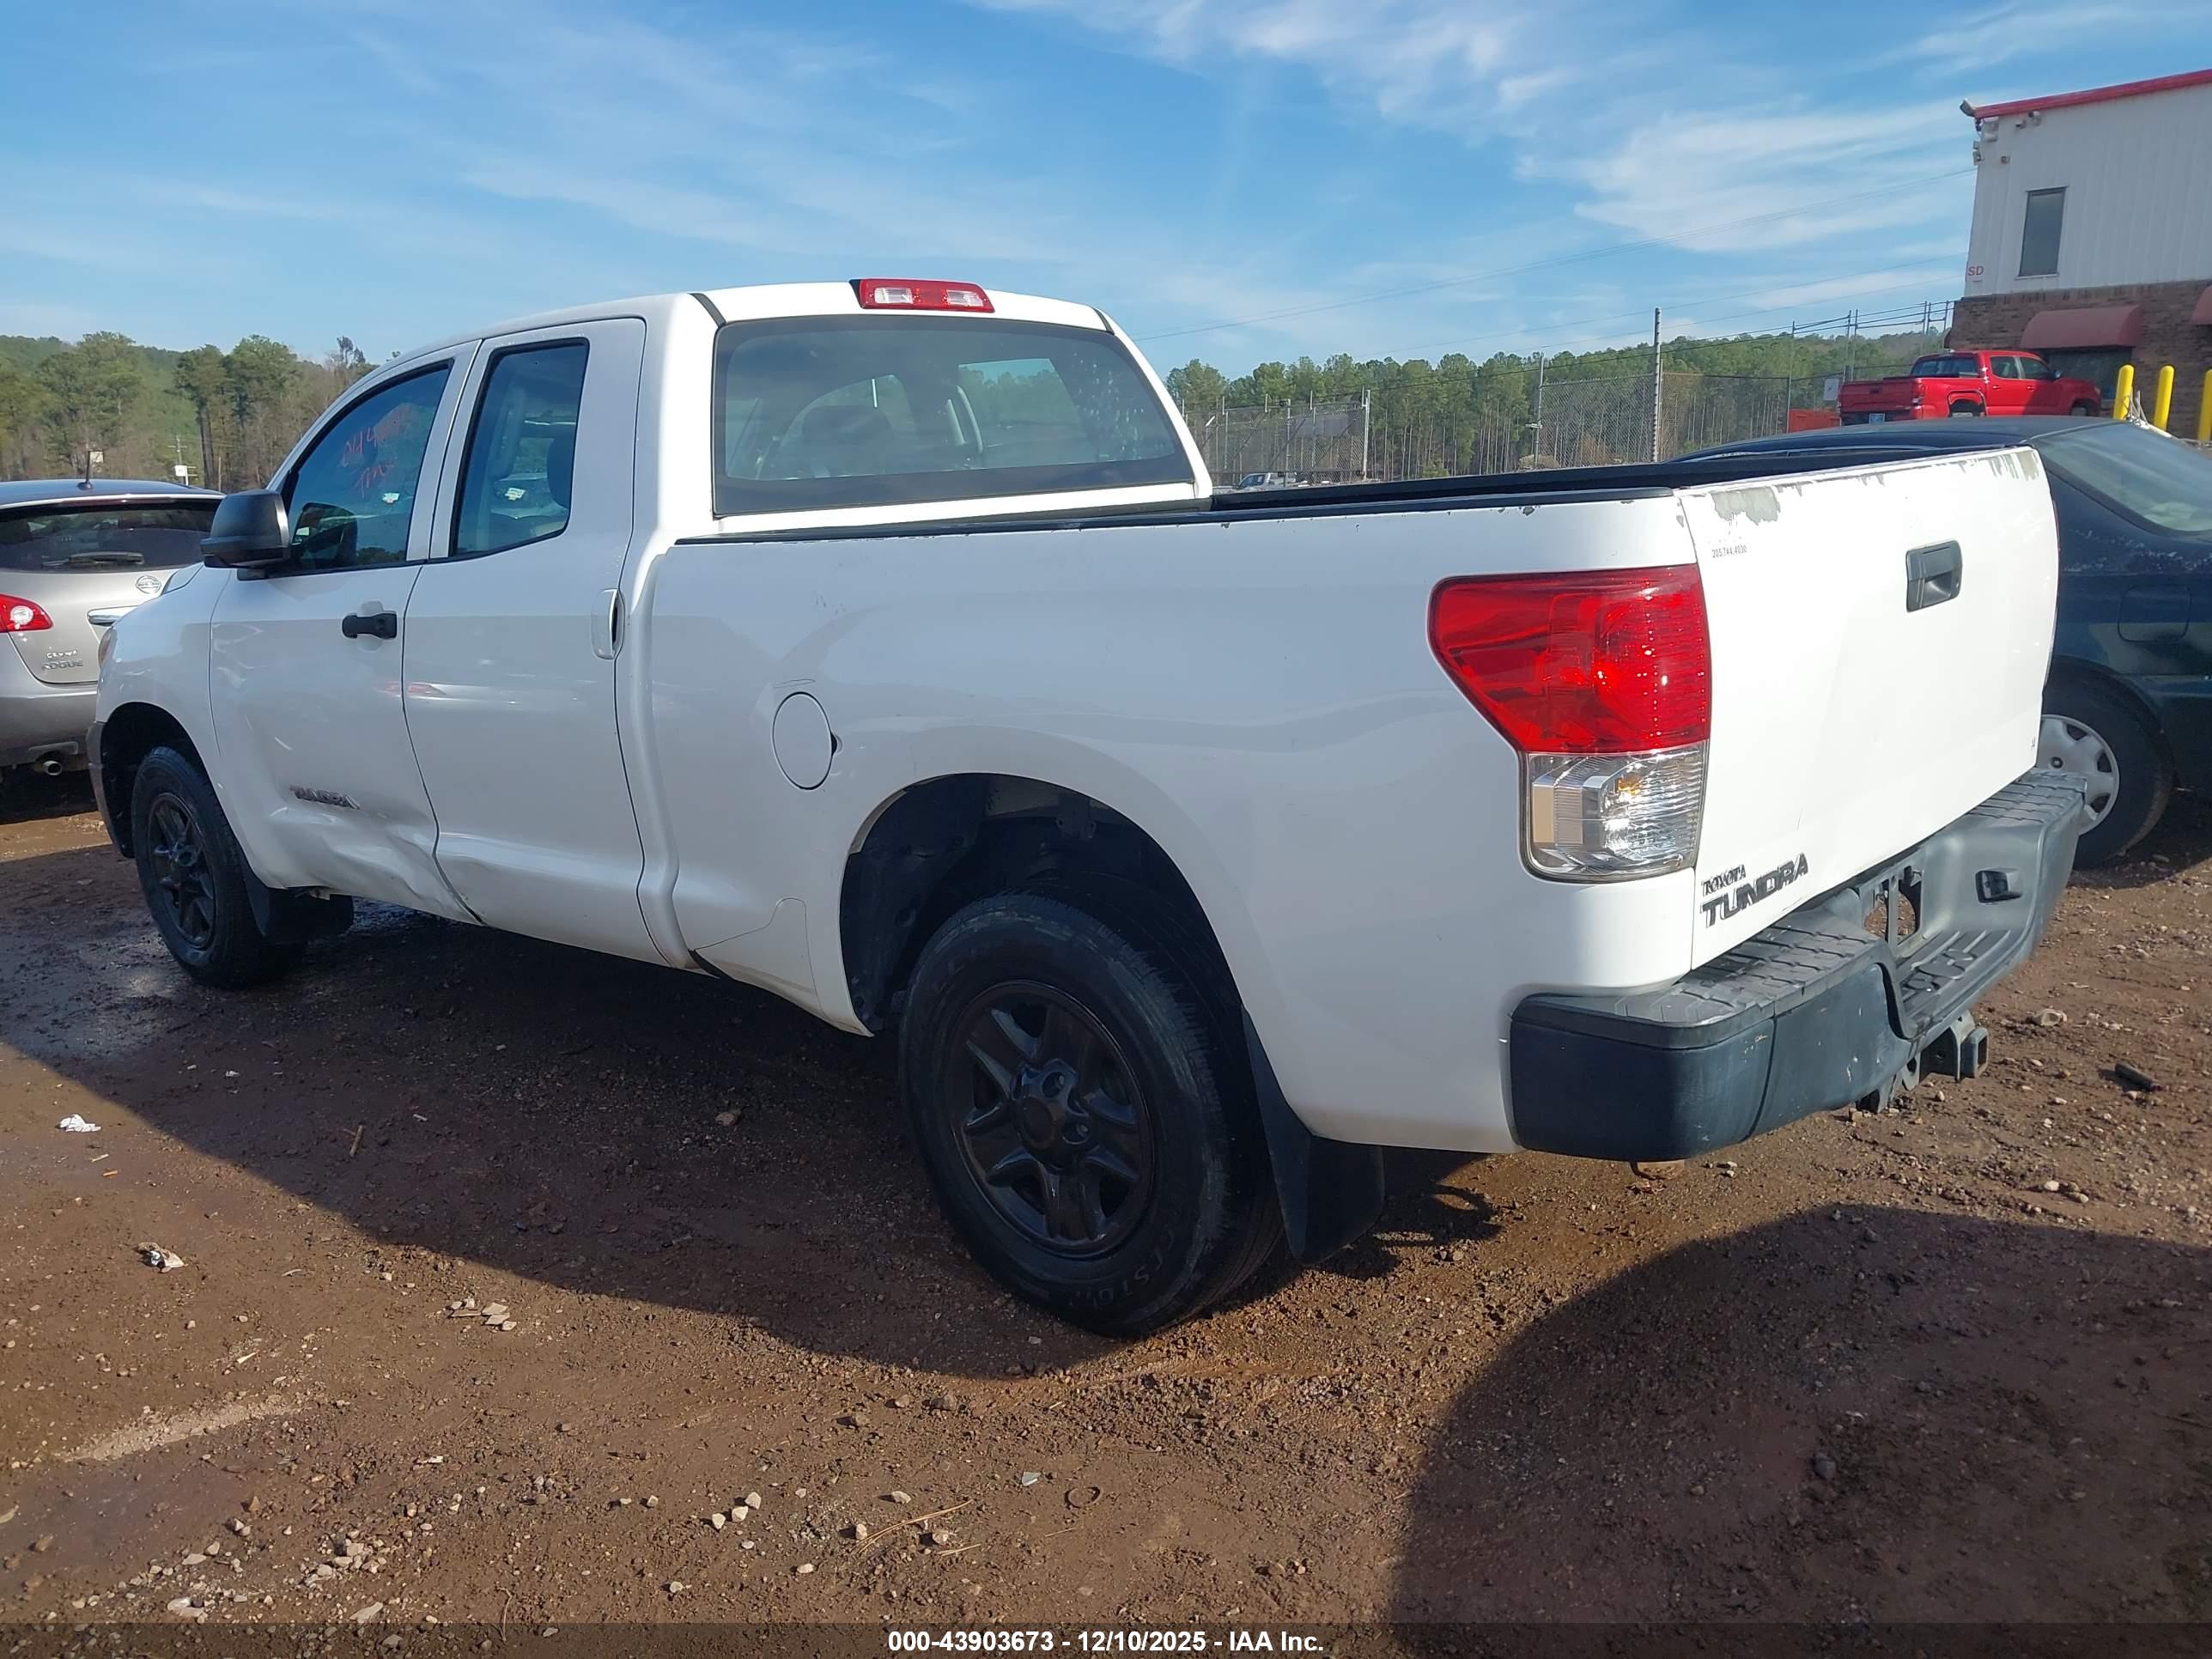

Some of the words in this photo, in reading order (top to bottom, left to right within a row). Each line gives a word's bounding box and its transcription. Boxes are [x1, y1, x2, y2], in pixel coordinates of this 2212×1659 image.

[1968, 265, 1984, 276] SD
[1700, 852, 1808, 928] TUNDRA
[1701, 864, 1747, 896] TOYOTA
